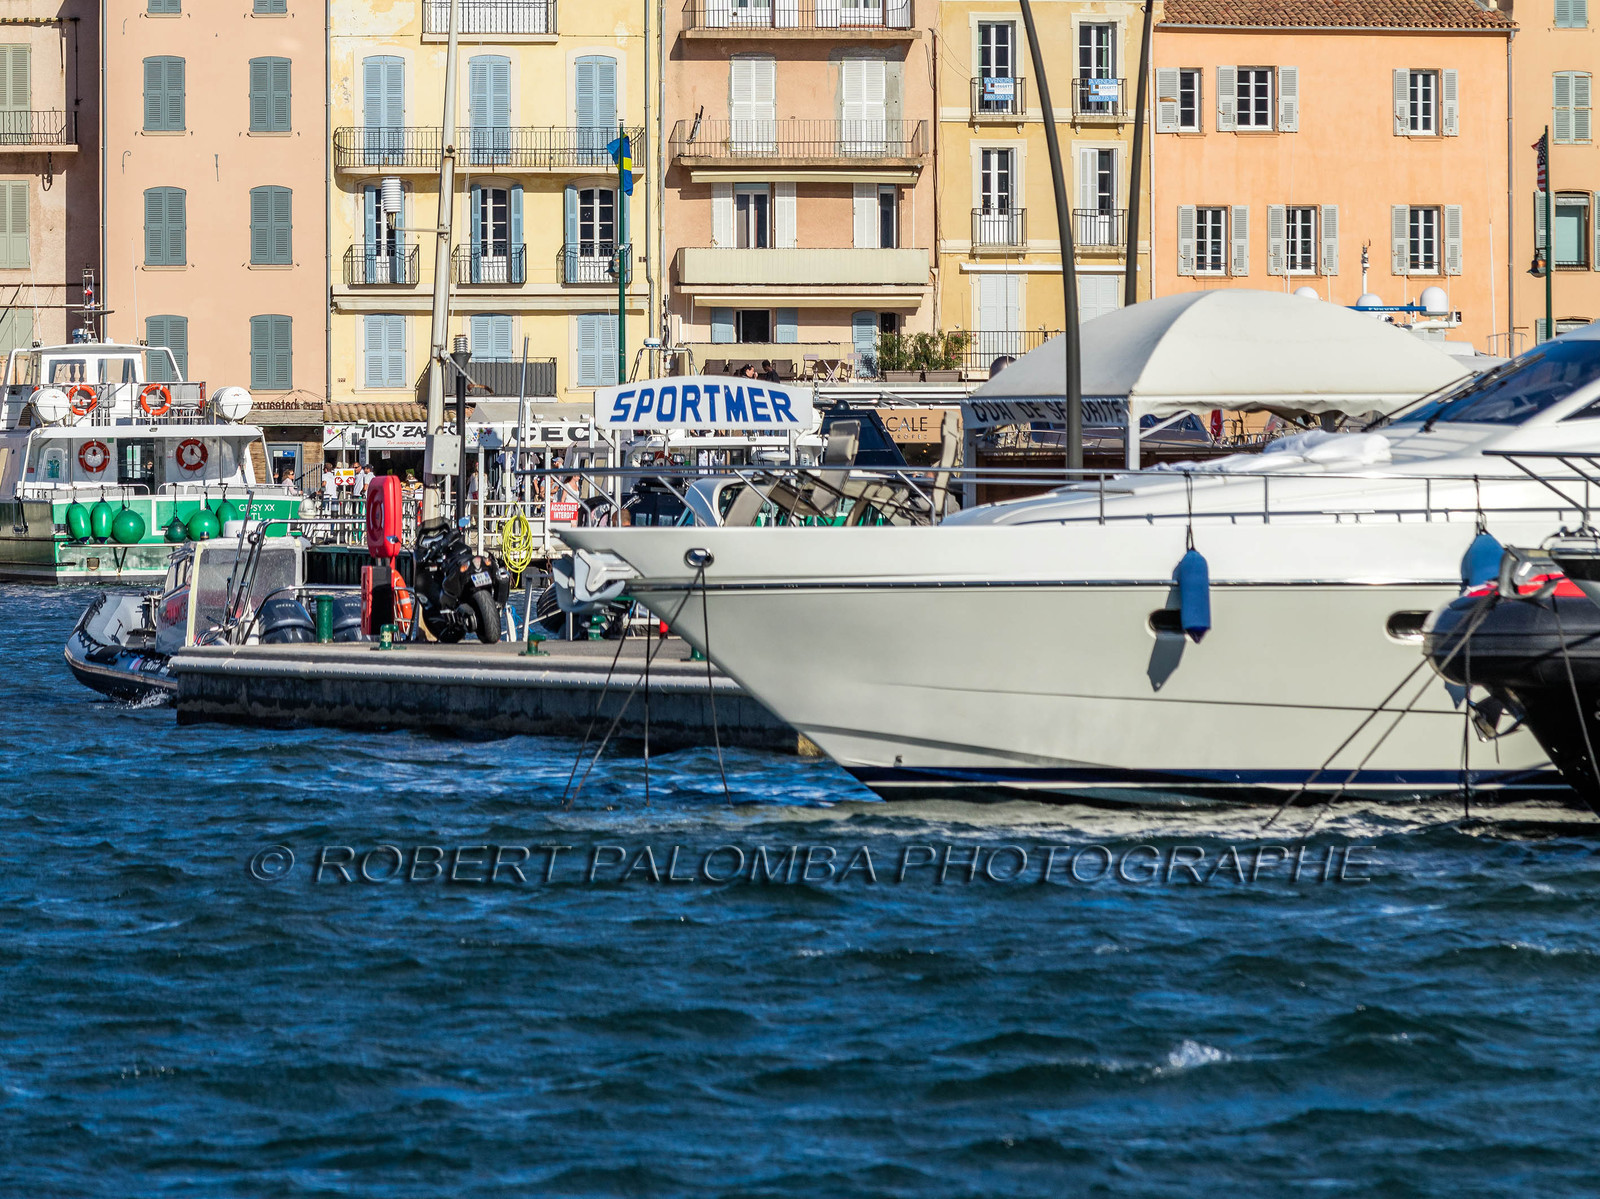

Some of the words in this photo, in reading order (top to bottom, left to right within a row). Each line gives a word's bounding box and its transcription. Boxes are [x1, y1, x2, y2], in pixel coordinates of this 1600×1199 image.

[609, 384, 799, 422] SPORTMER
[971, 401, 1016, 423] QUAI
[1016, 400, 1047, 420] DE
[361, 423, 401, 438] MISS'
[880, 416, 928, 432] CALE
[550, 503, 578, 511] ACCOSTAGE
[553, 511, 574, 519] INTERDIT
